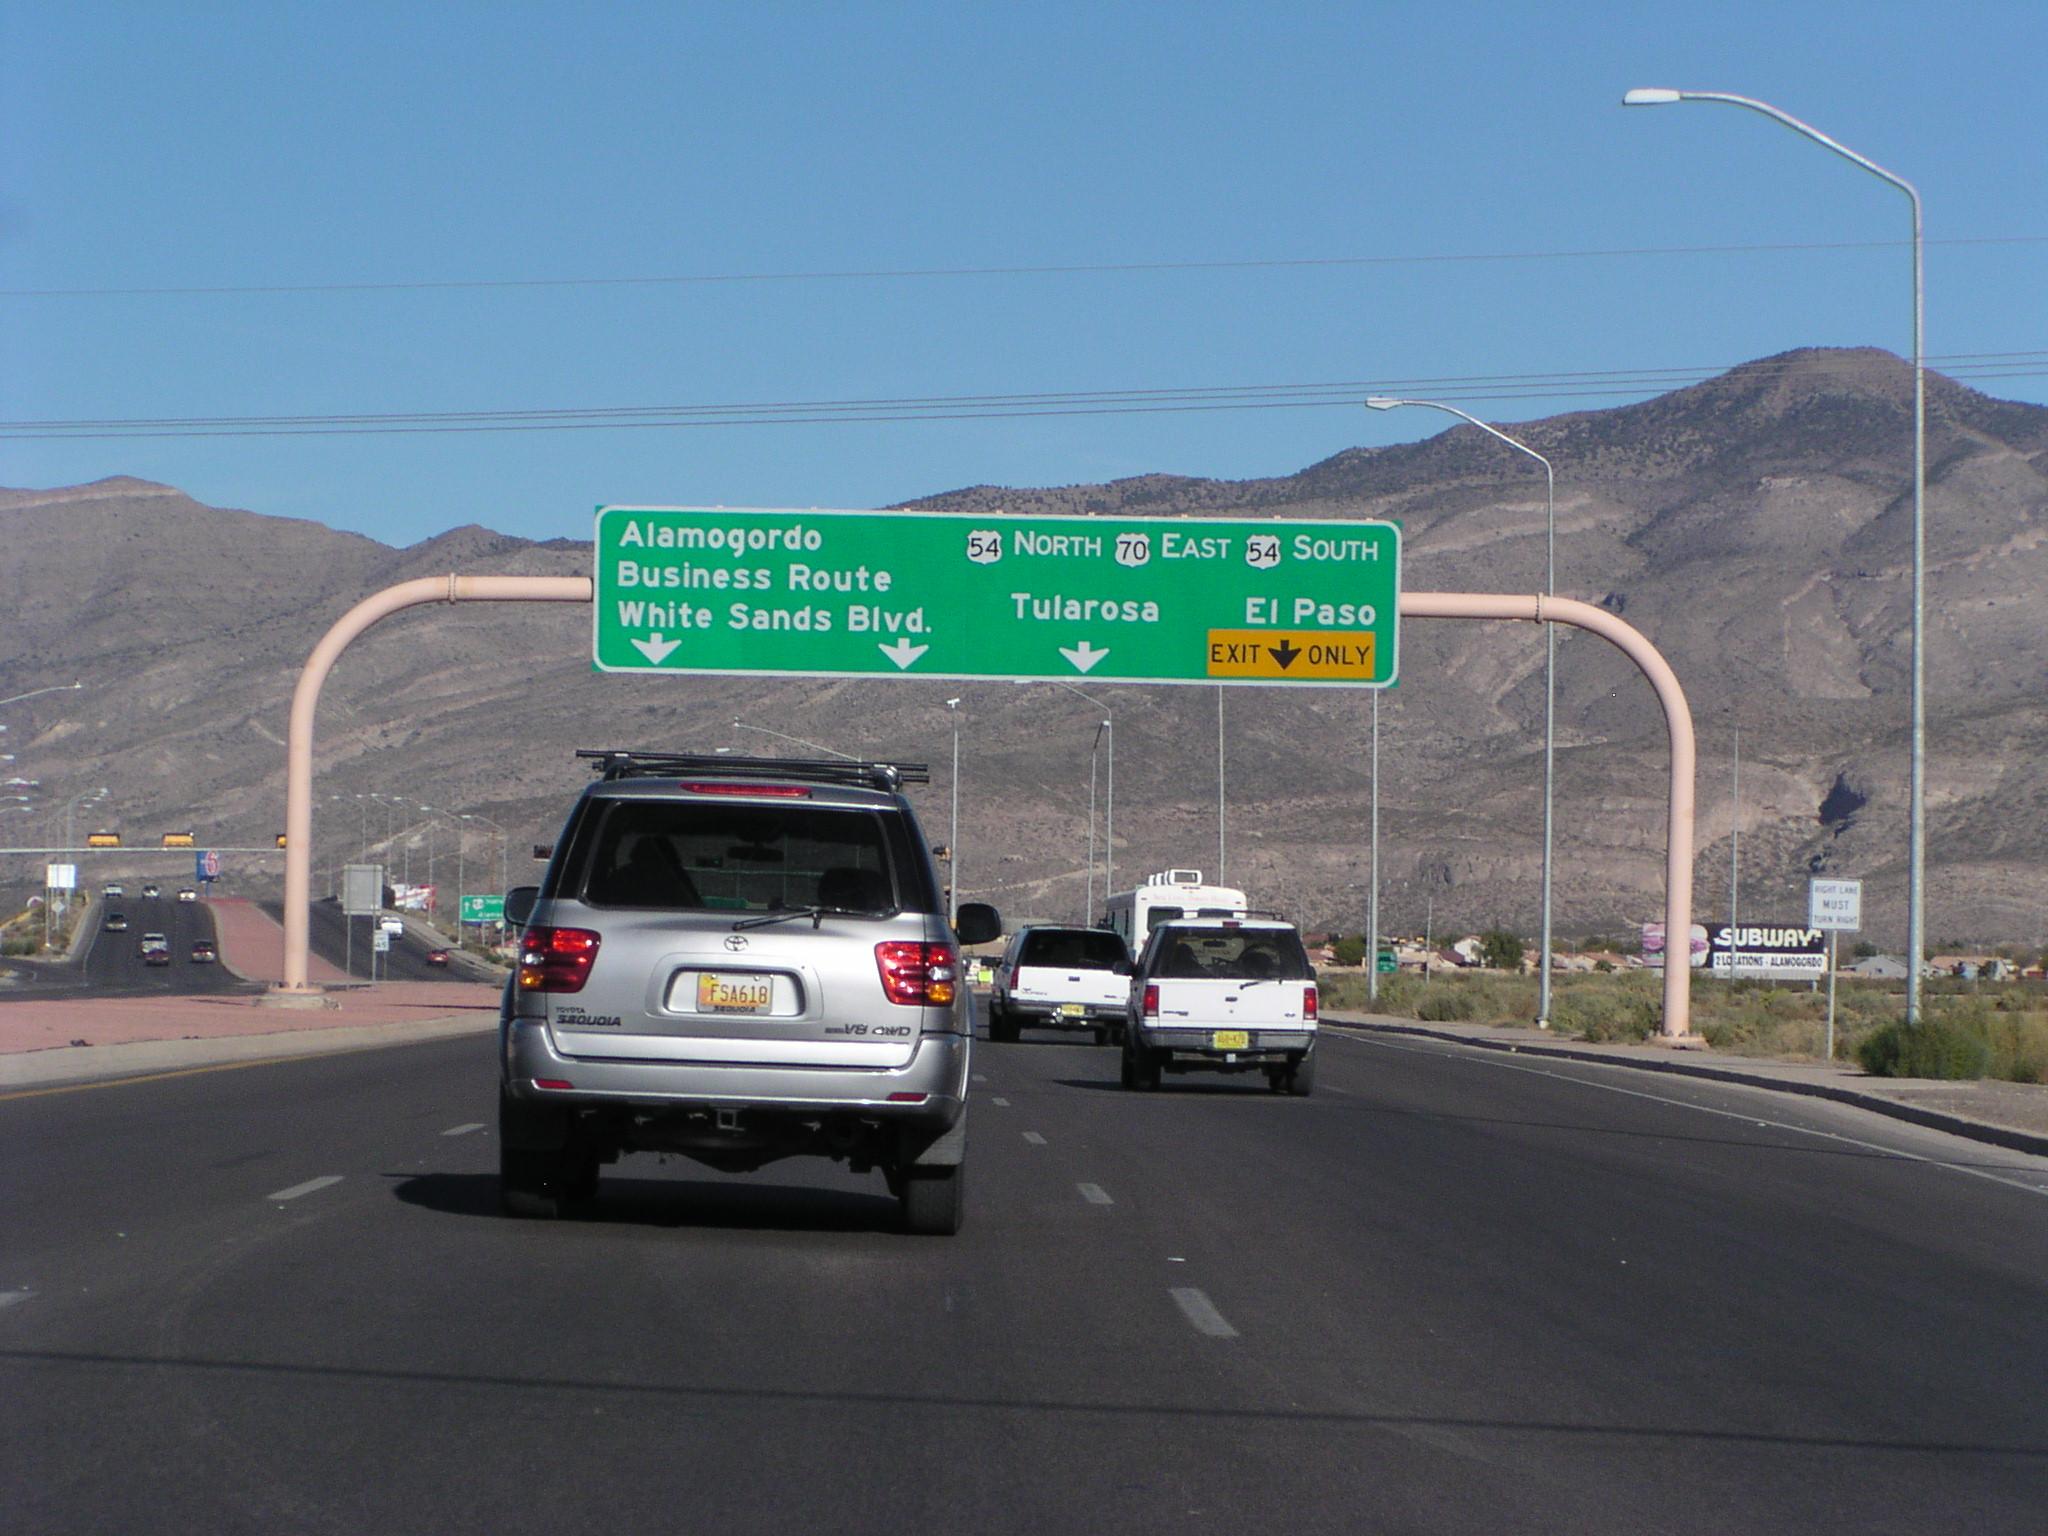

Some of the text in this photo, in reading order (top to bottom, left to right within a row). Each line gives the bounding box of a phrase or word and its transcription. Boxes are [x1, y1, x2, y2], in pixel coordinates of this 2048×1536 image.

[619, 520, 824, 558] Alamogordo
[968, 530, 1231, 562] 54 NORTH 70 EAST
[1249, 534, 1378, 562] 54 SOUTH
[618, 560, 893, 593] Business Route
[618, 600, 933, 634] White Sands Blvd.
[1011, 592, 1159, 623] Tularosa
[1246, 597, 1376, 626] El Paso
[1210, 642, 1370, 665] EXIT ONLY
[1823, 900, 1849, 910] MUST
[1713, 928, 1823, 947] SUBWAY
[1723, 956, 1764, 967] LOATIONS
[556, 1014, 622, 1027] SEQUOIA
